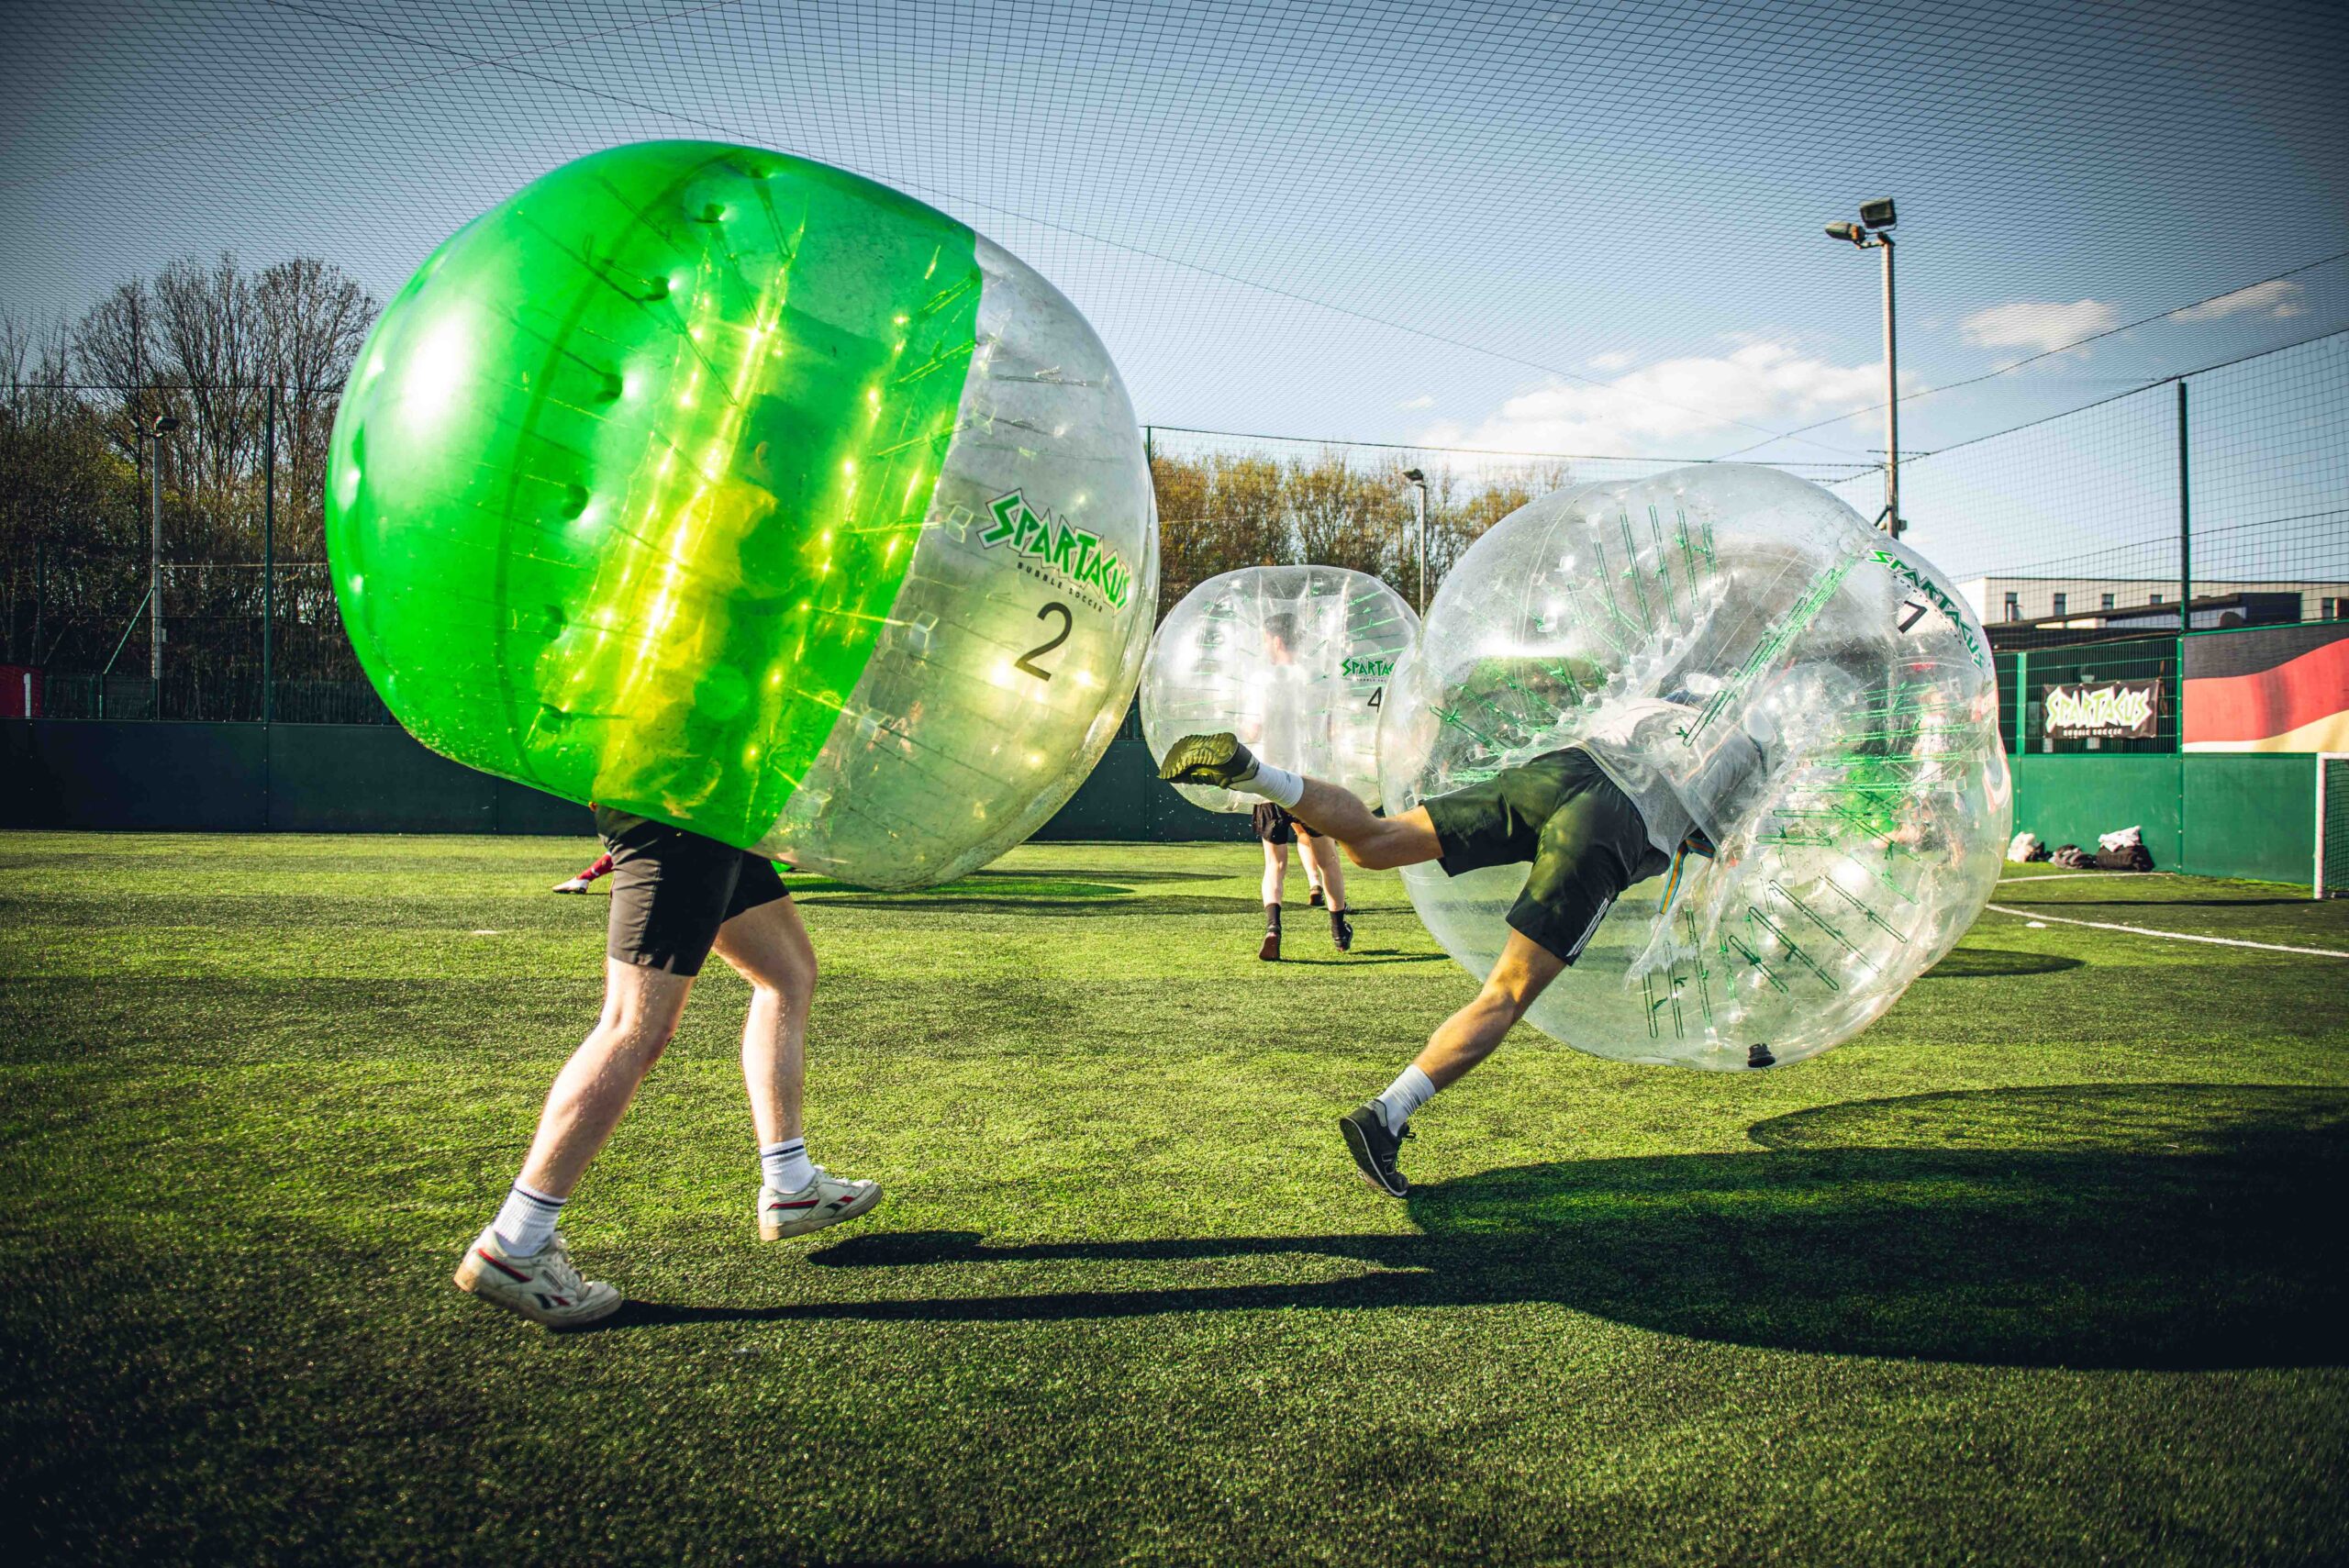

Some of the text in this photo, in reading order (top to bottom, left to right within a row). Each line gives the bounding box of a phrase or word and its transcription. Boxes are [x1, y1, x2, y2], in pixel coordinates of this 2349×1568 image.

[983, 494, 1130, 611] SPARTACUS
[1018, 561, 1063, 589] BUBBLE
[1866, 549, 1985, 669] SPARTACUS
[1014, 601, 1073, 682] 2
[1341, 657, 1395, 676] SPARTAC
[1367, 686, 1383, 713] 4
[2046, 686, 2152, 732] SPARTACUS
